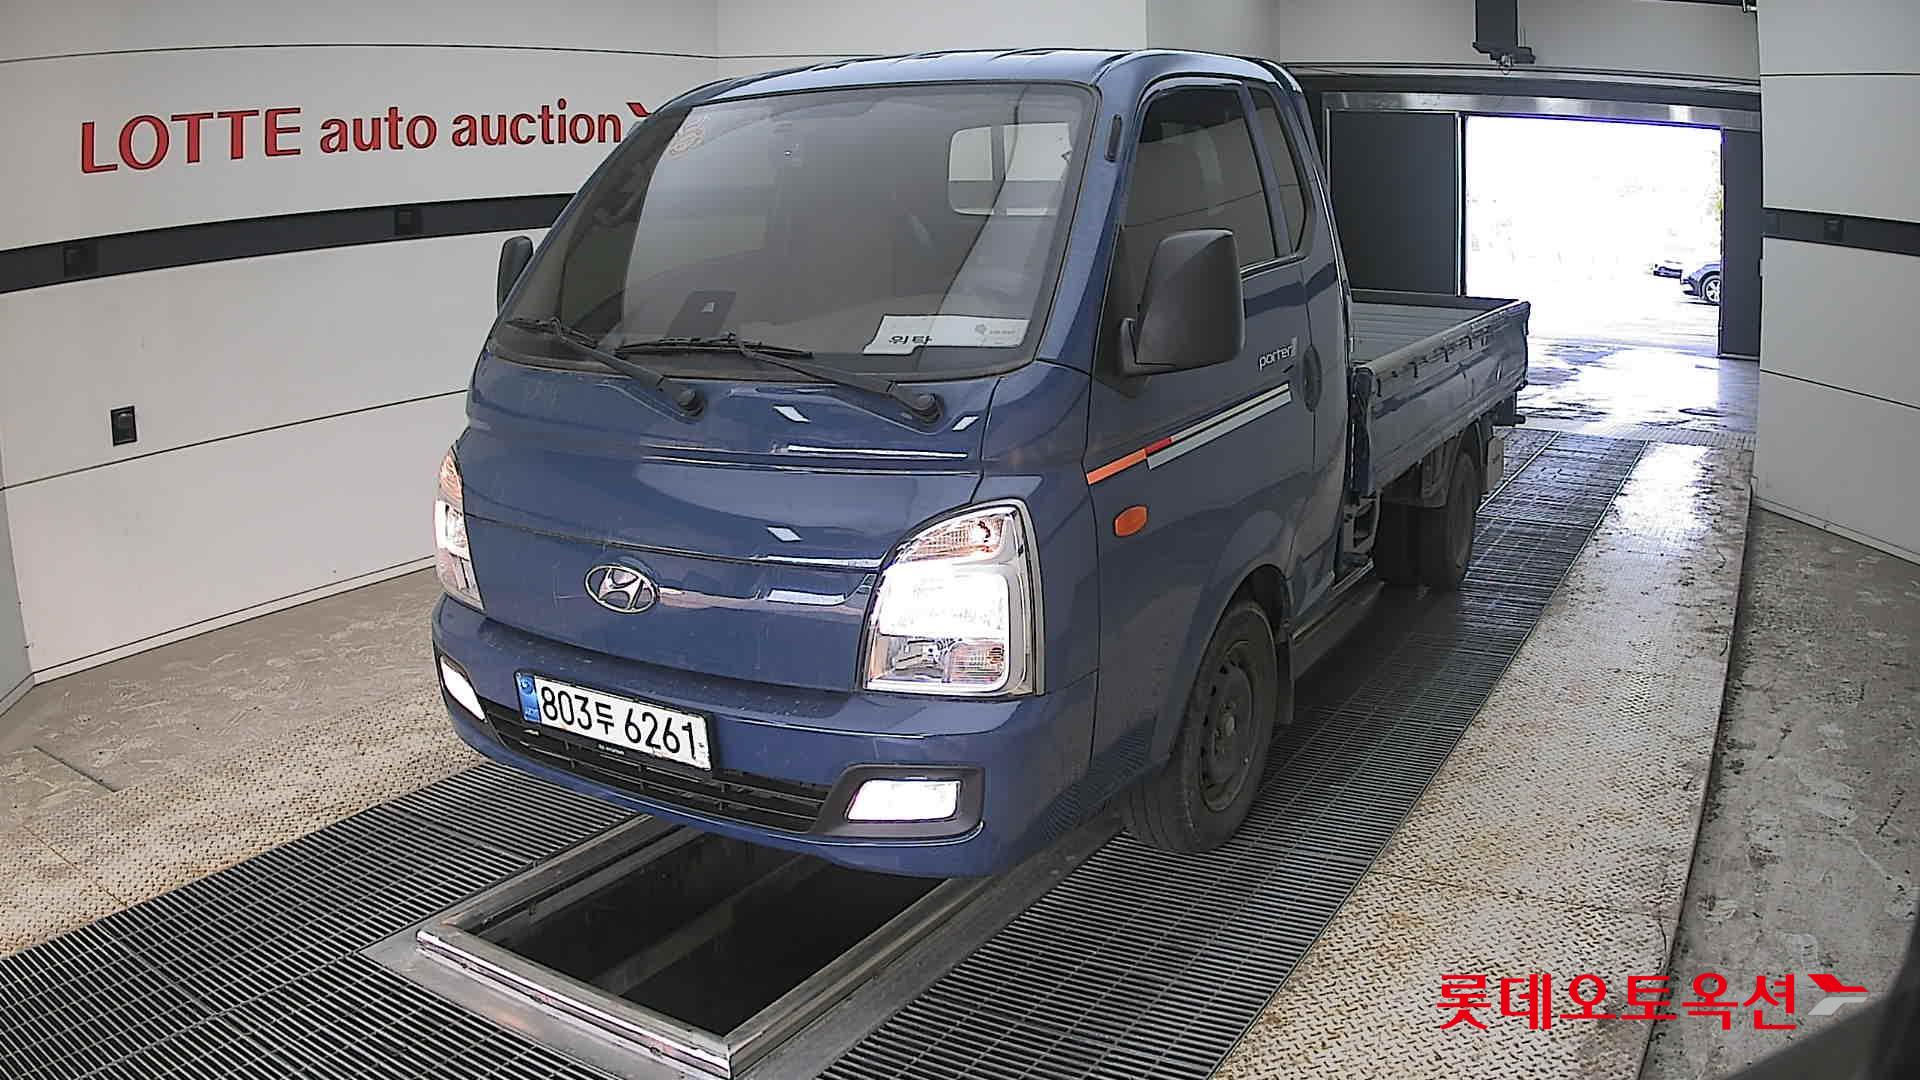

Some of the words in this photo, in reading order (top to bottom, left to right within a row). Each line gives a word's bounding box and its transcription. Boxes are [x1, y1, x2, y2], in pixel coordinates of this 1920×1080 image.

[81, 106, 301, 174] LOTTE
[319, 105, 438, 154] auto
[451, 98, 623, 147] auction
[541, 686, 616, 735] 803두
[624, 707, 698, 760] 6261
